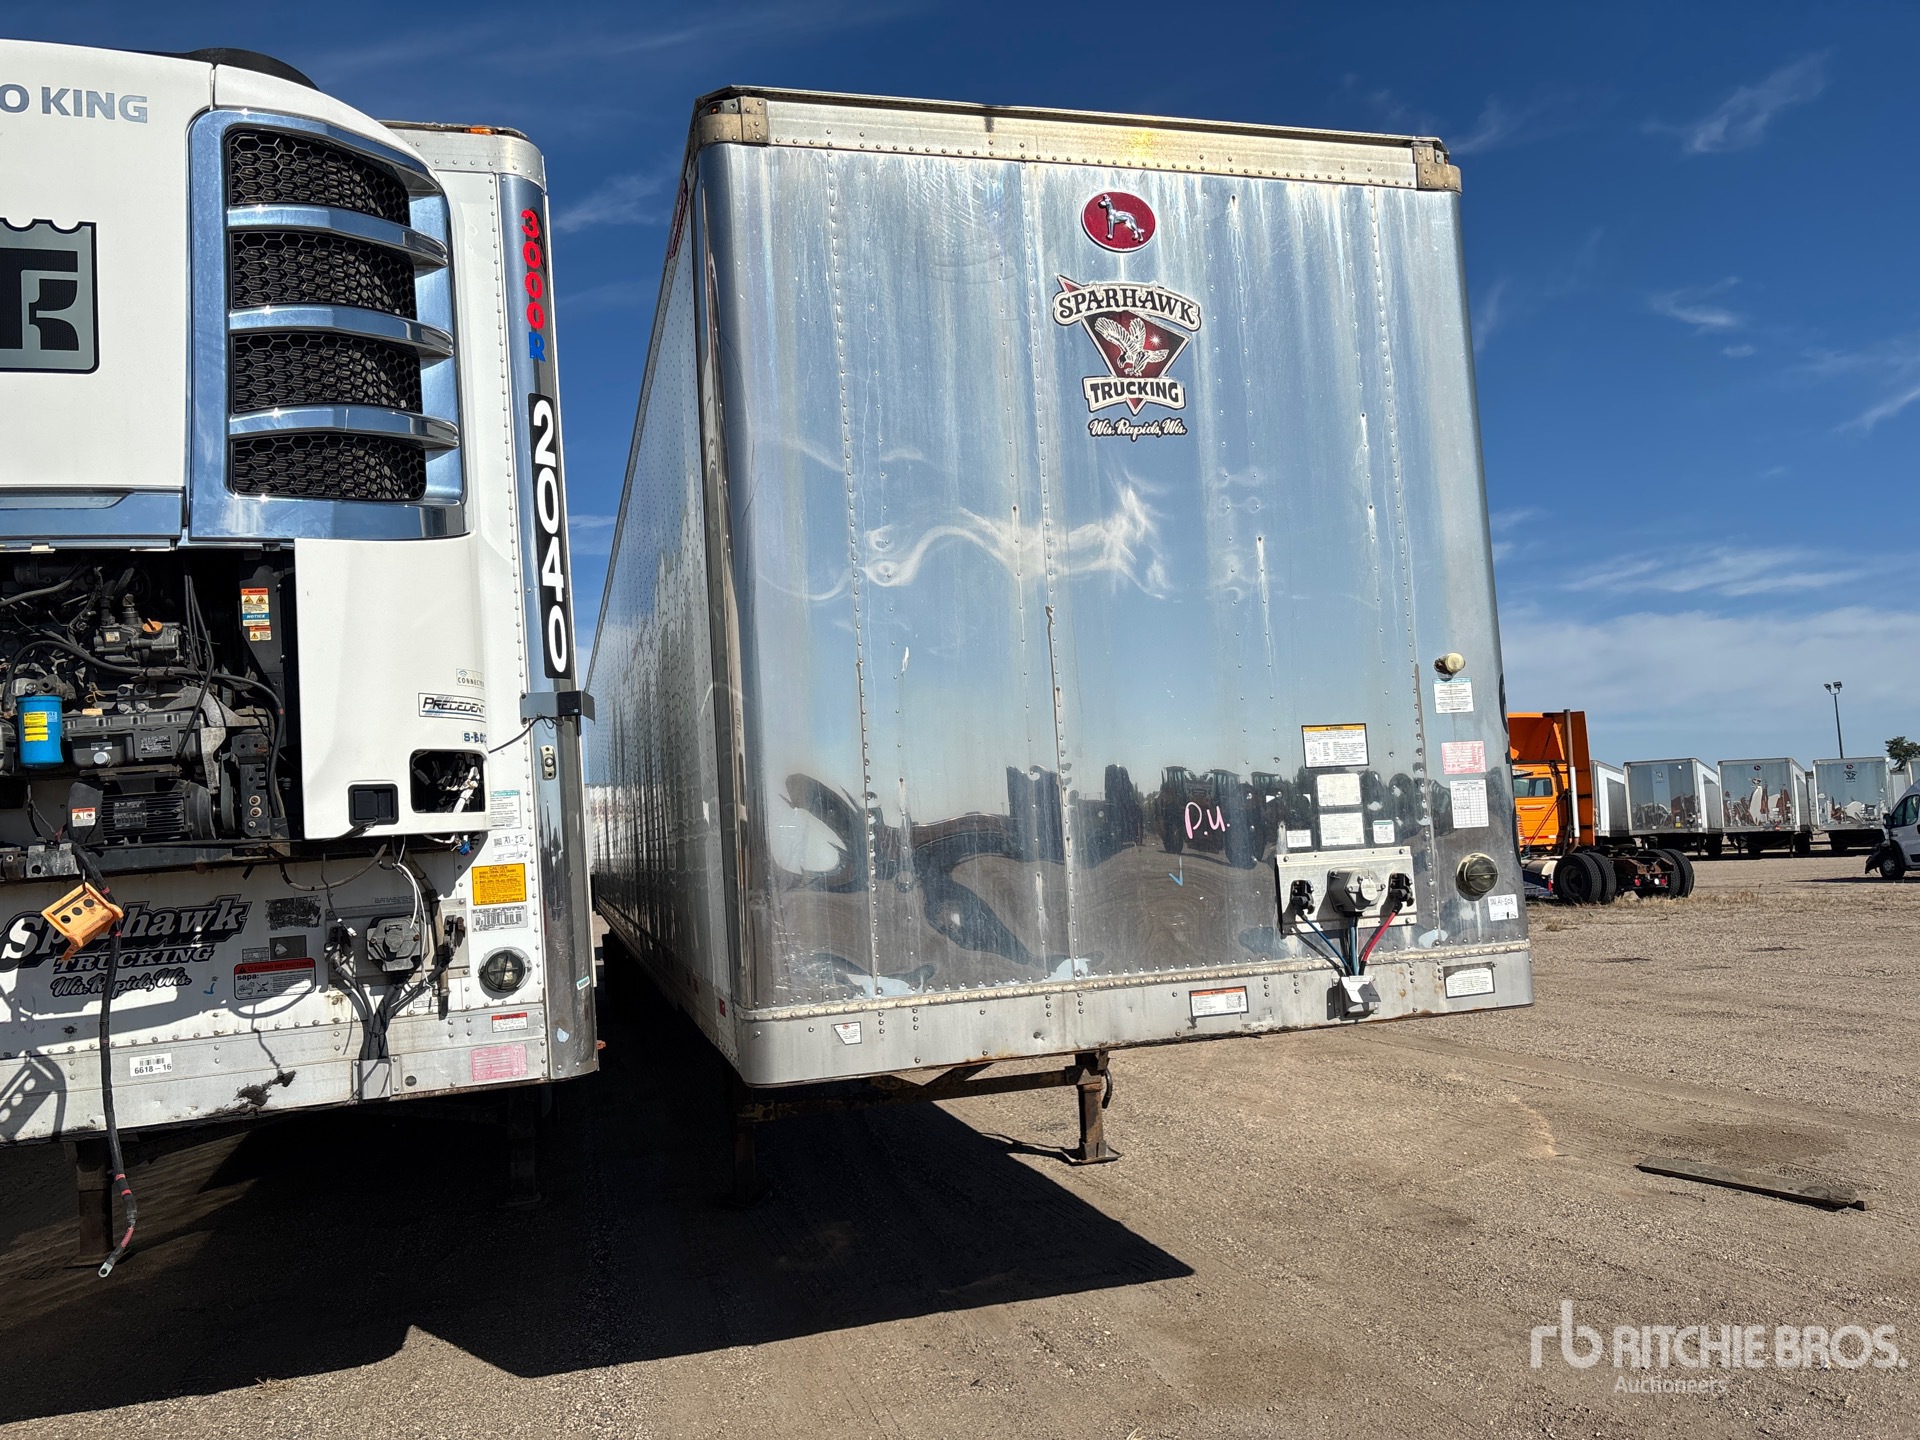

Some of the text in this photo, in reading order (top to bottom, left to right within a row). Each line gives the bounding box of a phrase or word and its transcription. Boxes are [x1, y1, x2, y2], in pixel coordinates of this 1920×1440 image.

[41, 86, 148, 123] KING
[1058, 288, 1195, 325] SPARHAWK
[1090, 381, 1180, 403] TRUCKING
[1089, 416, 1187, 441] Wis. Rapids, Wis.
[533, 399, 567, 673] 2040
[88, 972, 154, 998] Rpids,
[153, 967, 192, 987] Wis.
